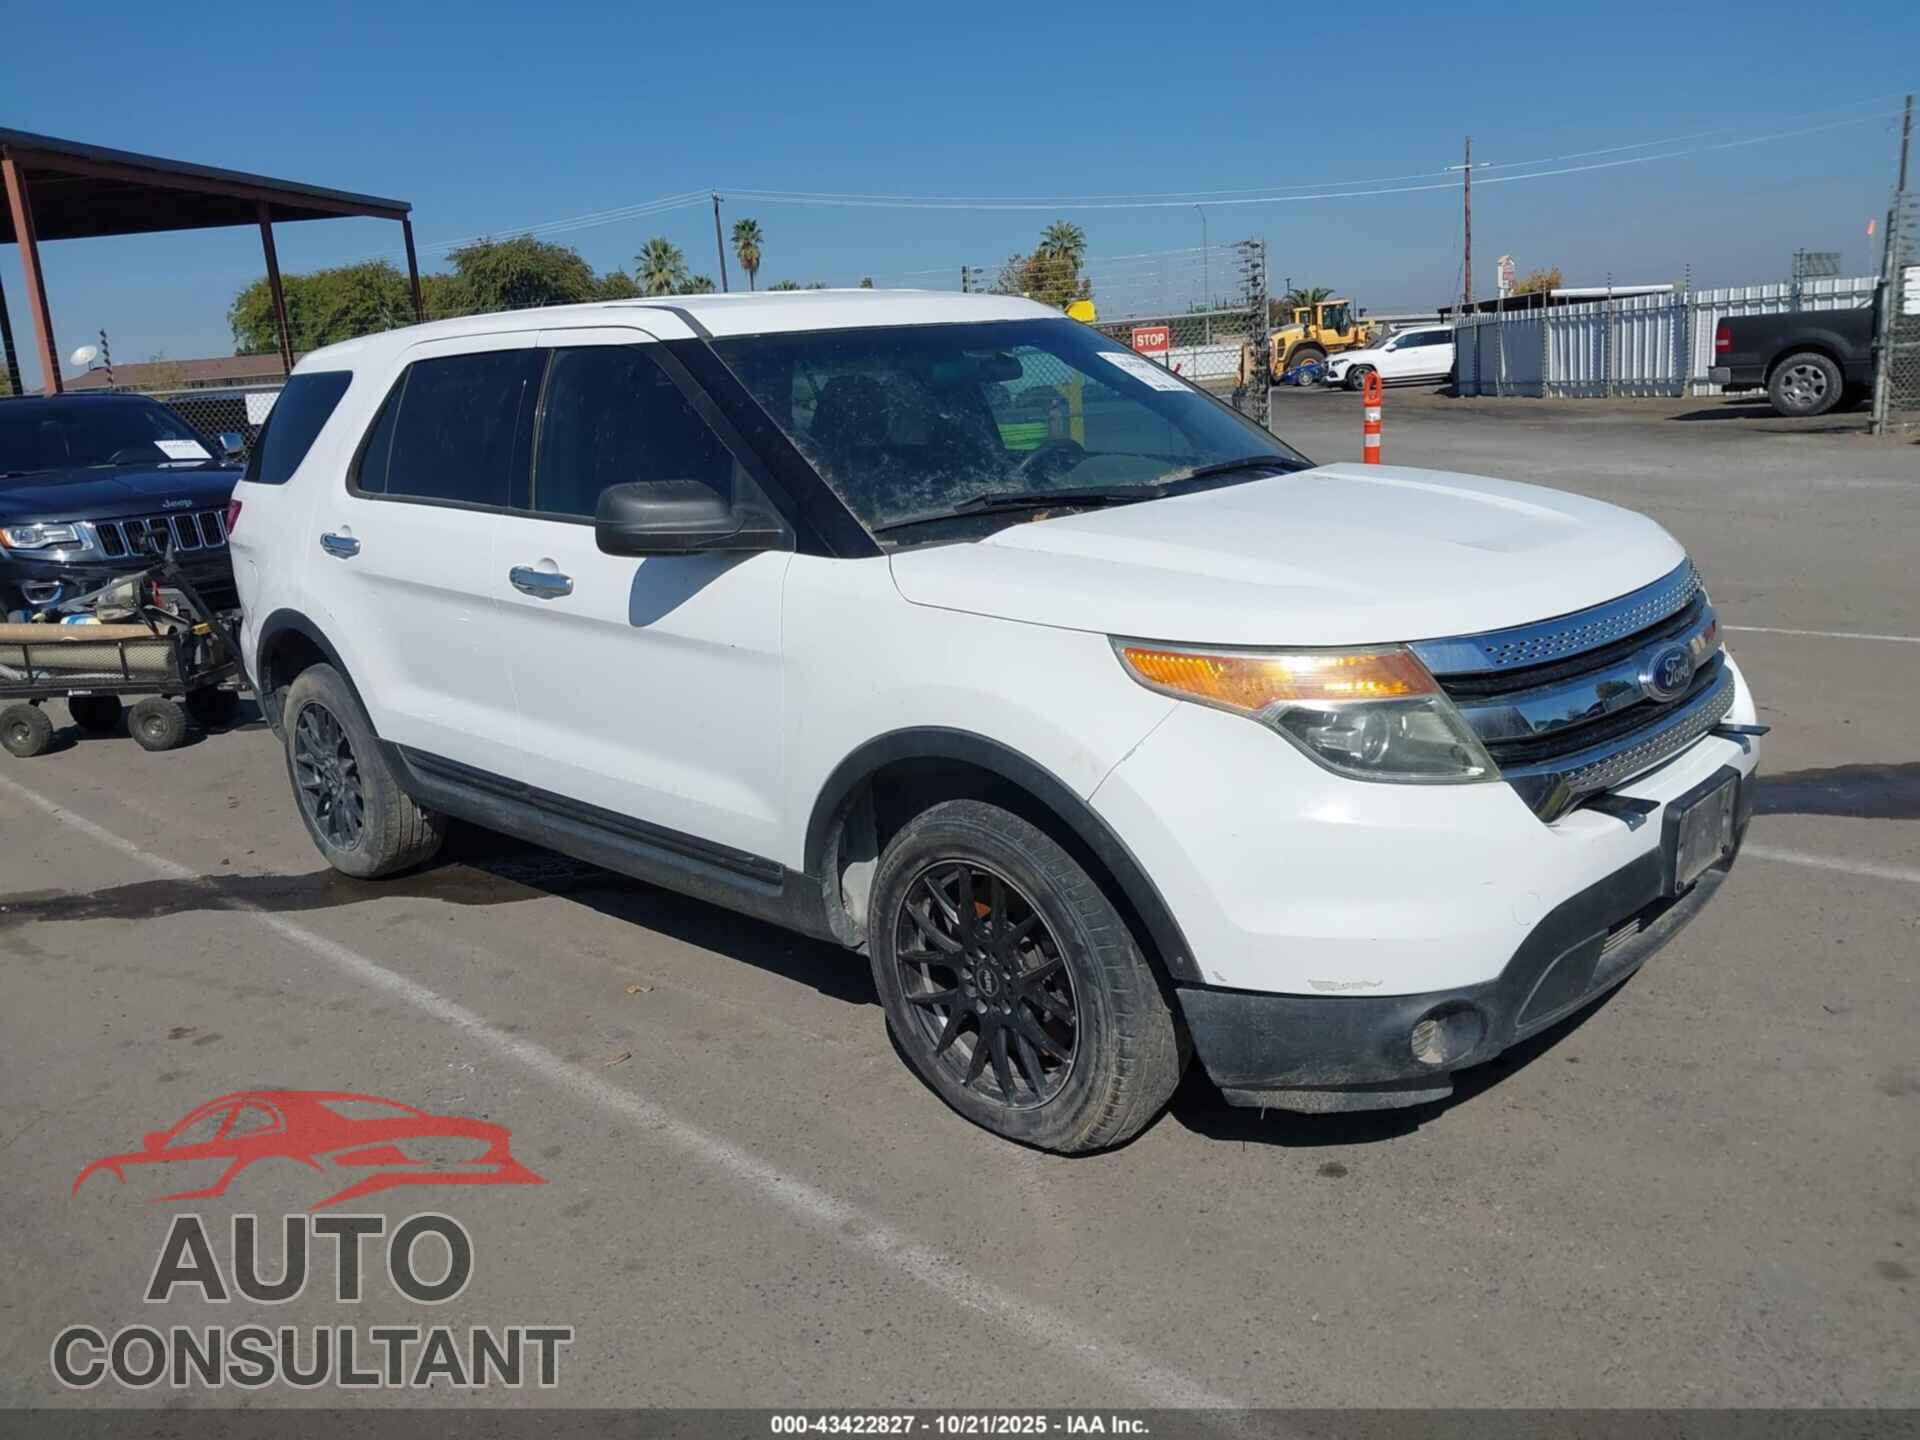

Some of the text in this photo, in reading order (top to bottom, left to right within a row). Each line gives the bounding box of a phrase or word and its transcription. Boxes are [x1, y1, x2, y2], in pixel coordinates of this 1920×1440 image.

[1137, 333, 1165, 346] STOP
[162, 499, 193, 508] Jeep
[1664, 655, 1691, 686] Ford
